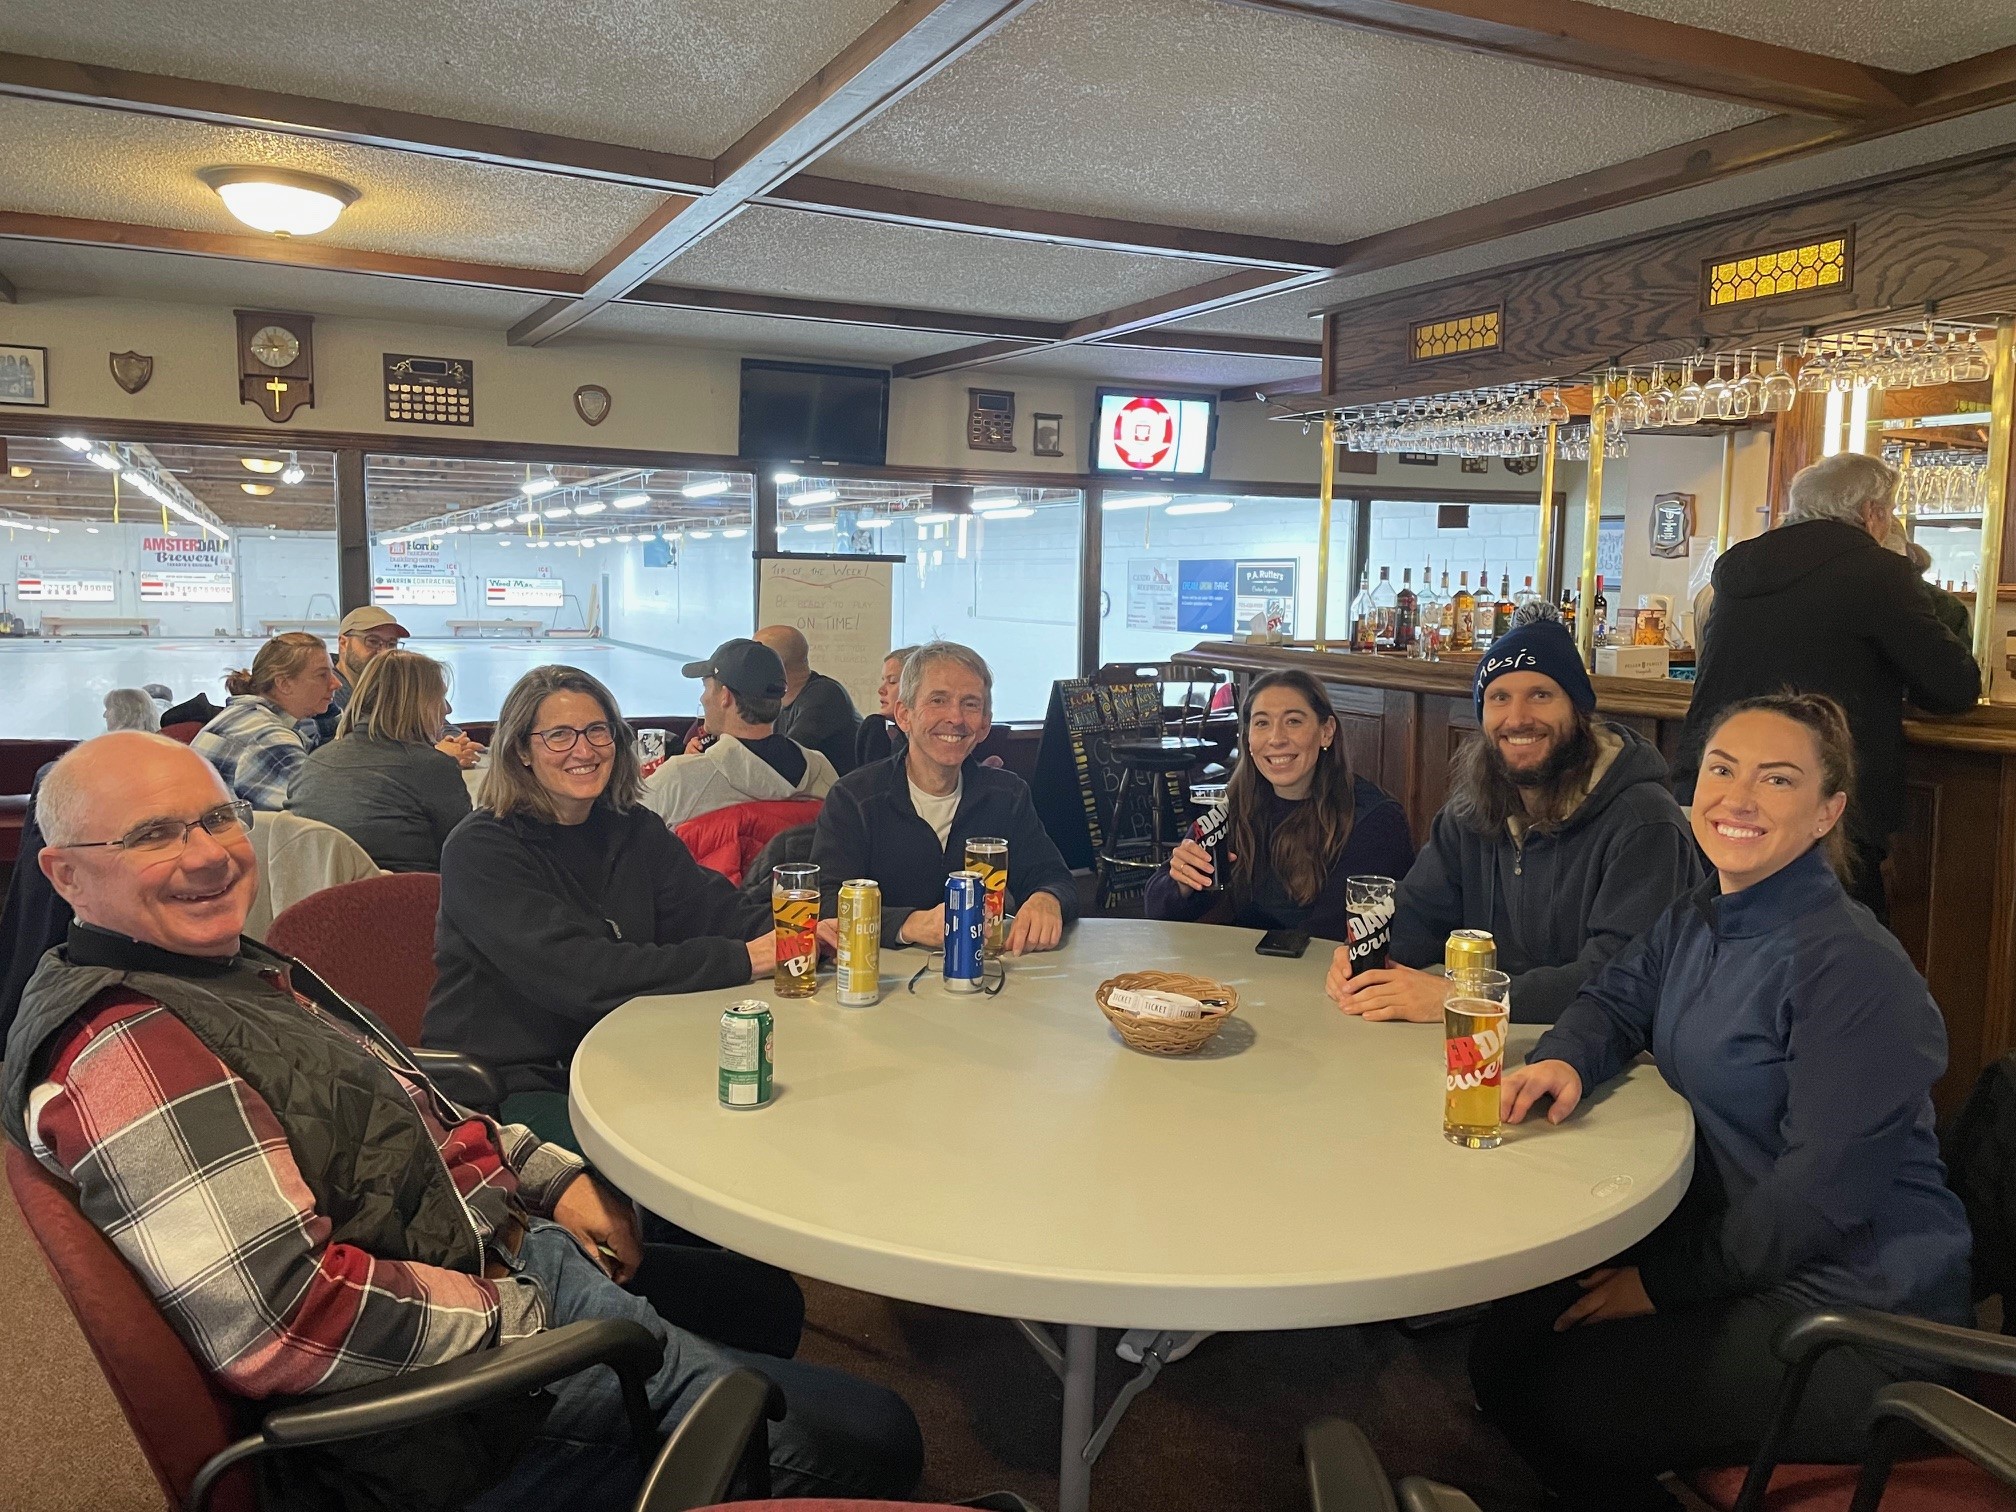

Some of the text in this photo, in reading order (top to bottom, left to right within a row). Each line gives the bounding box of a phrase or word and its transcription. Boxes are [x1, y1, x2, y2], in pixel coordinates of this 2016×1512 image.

[143, 538, 229, 552] AMSTERDAM
[155, 552, 219, 566] Brewery
[797, 614, 860, 630] ON TIME!
[1113, 993, 1132, 1005] TICKET
[1145, 1002, 1167, 1014] TICKET
[1180, 1009, 1196, 1019] TICKET
